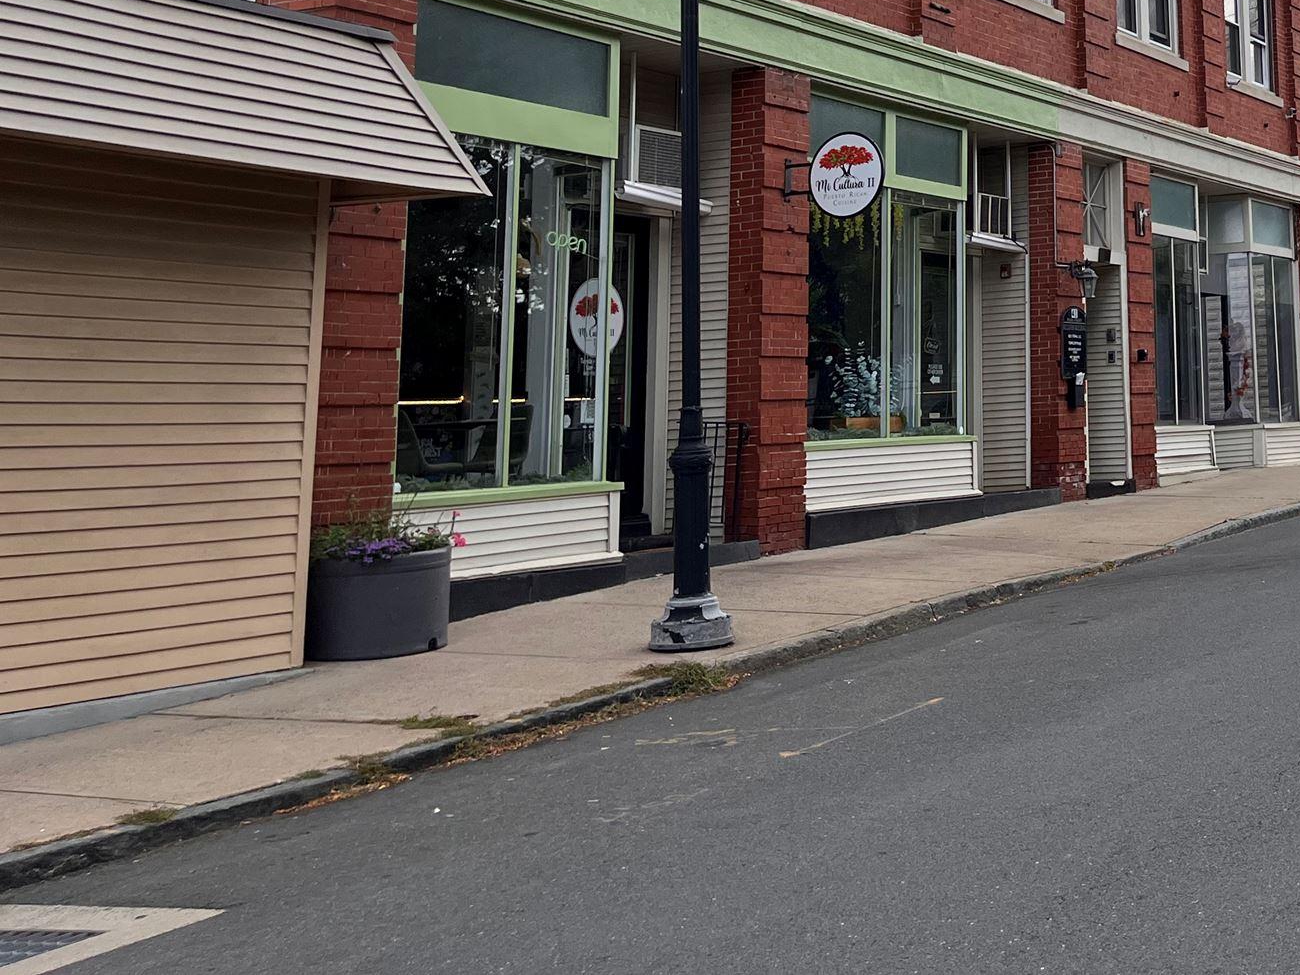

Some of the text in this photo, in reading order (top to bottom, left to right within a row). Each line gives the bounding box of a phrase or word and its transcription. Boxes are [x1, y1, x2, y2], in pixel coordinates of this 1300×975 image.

[815, 176, 875, 193] Mi Cultura II
[546, 231, 587, 255] open
